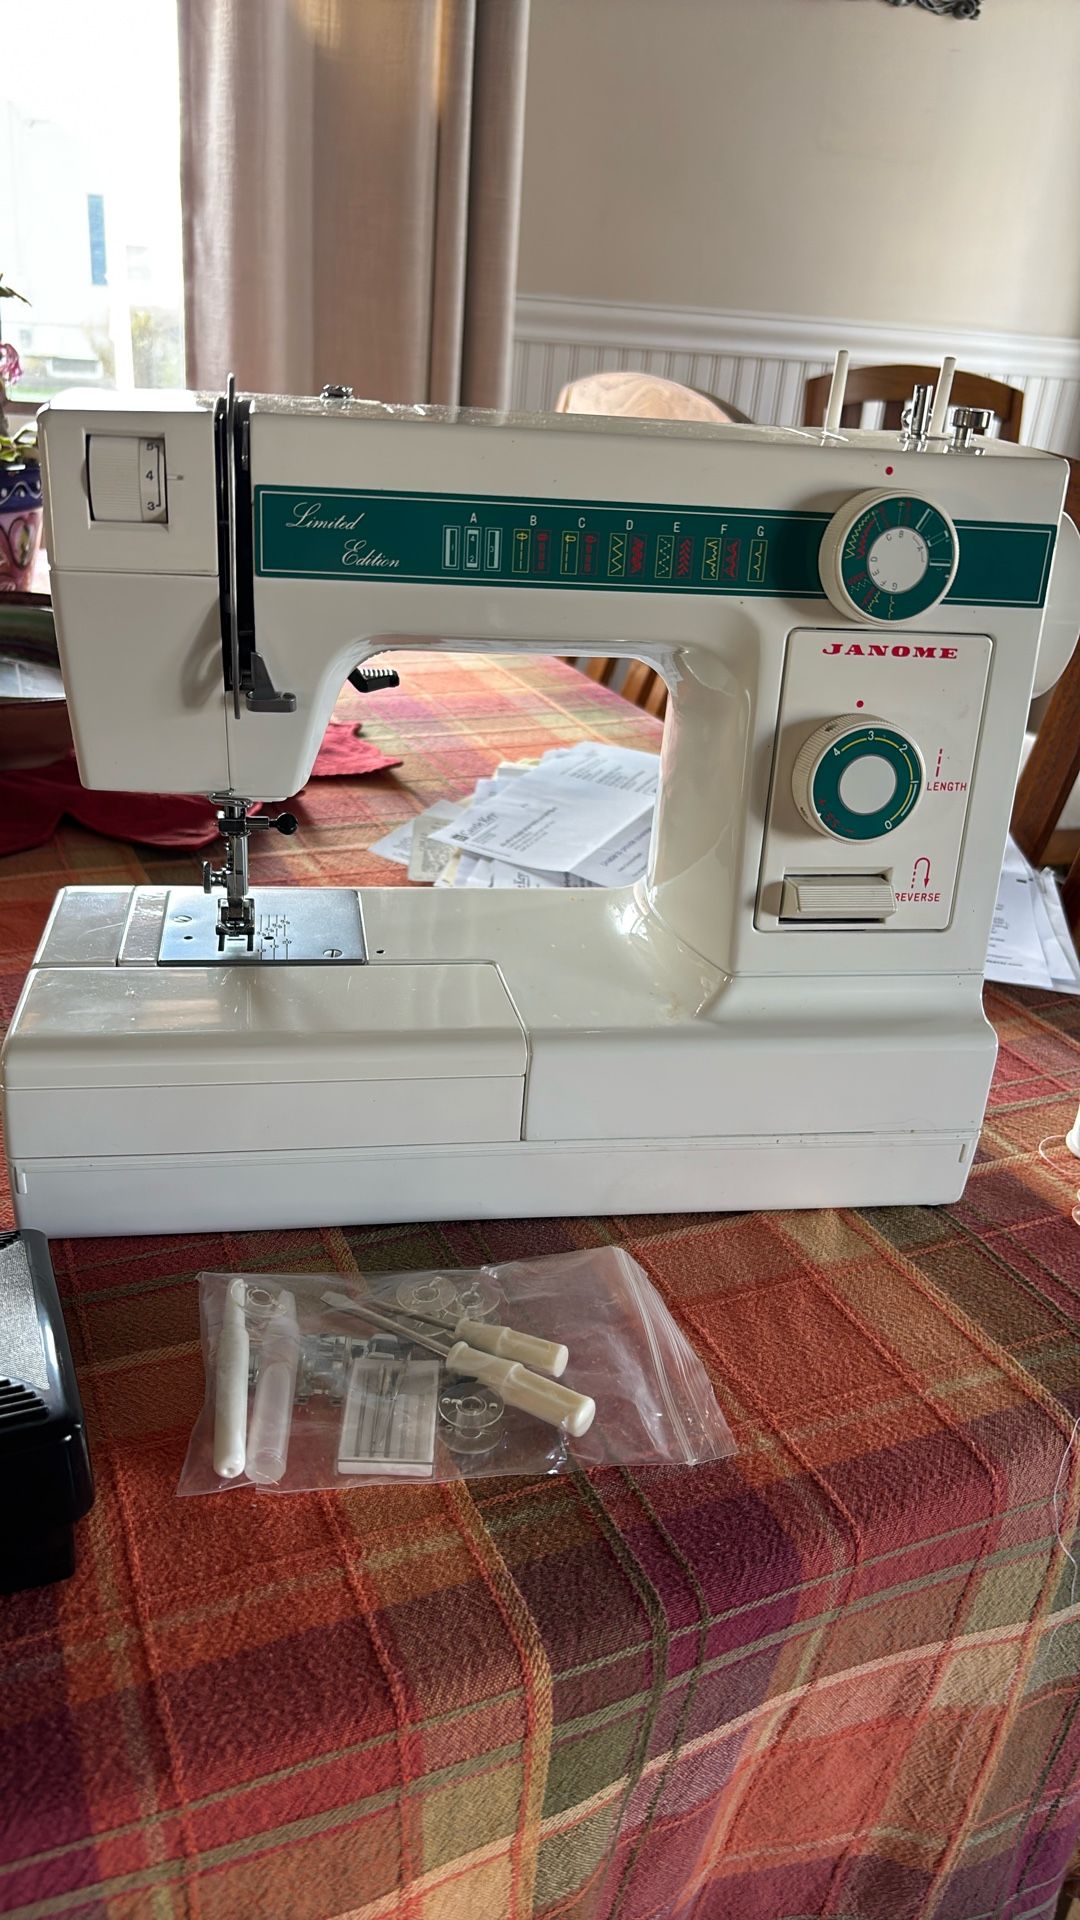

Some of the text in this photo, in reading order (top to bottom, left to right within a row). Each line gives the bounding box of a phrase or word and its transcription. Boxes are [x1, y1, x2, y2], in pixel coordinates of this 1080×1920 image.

[145, 470, 154, 480] 4
[147, 501, 156, 511] 3
[285, 502, 365, 530] Limited
[469, 512, 478, 524] A
[529, 514, 538, 526] B
[578, 517, 586, 529] C
[625, 519, 634, 531] D
[673, 521, 681, 533] E
[720, 524, 728, 535] F
[756, 525, 765, 537] G
[341, 539, 400, 568] Edition
[469, 555, 475, 563] 2
[822, 643, 958, 659] JANOME
[867, 730, 875, 741] 3
[832, 747, 841, 757] 4
[898, 743, 909, 754] 2
[926, 781, 968, 792] LENGTH
[884, 819, 894, 831] 0
[894, 892, 941, 902] REVERSE
